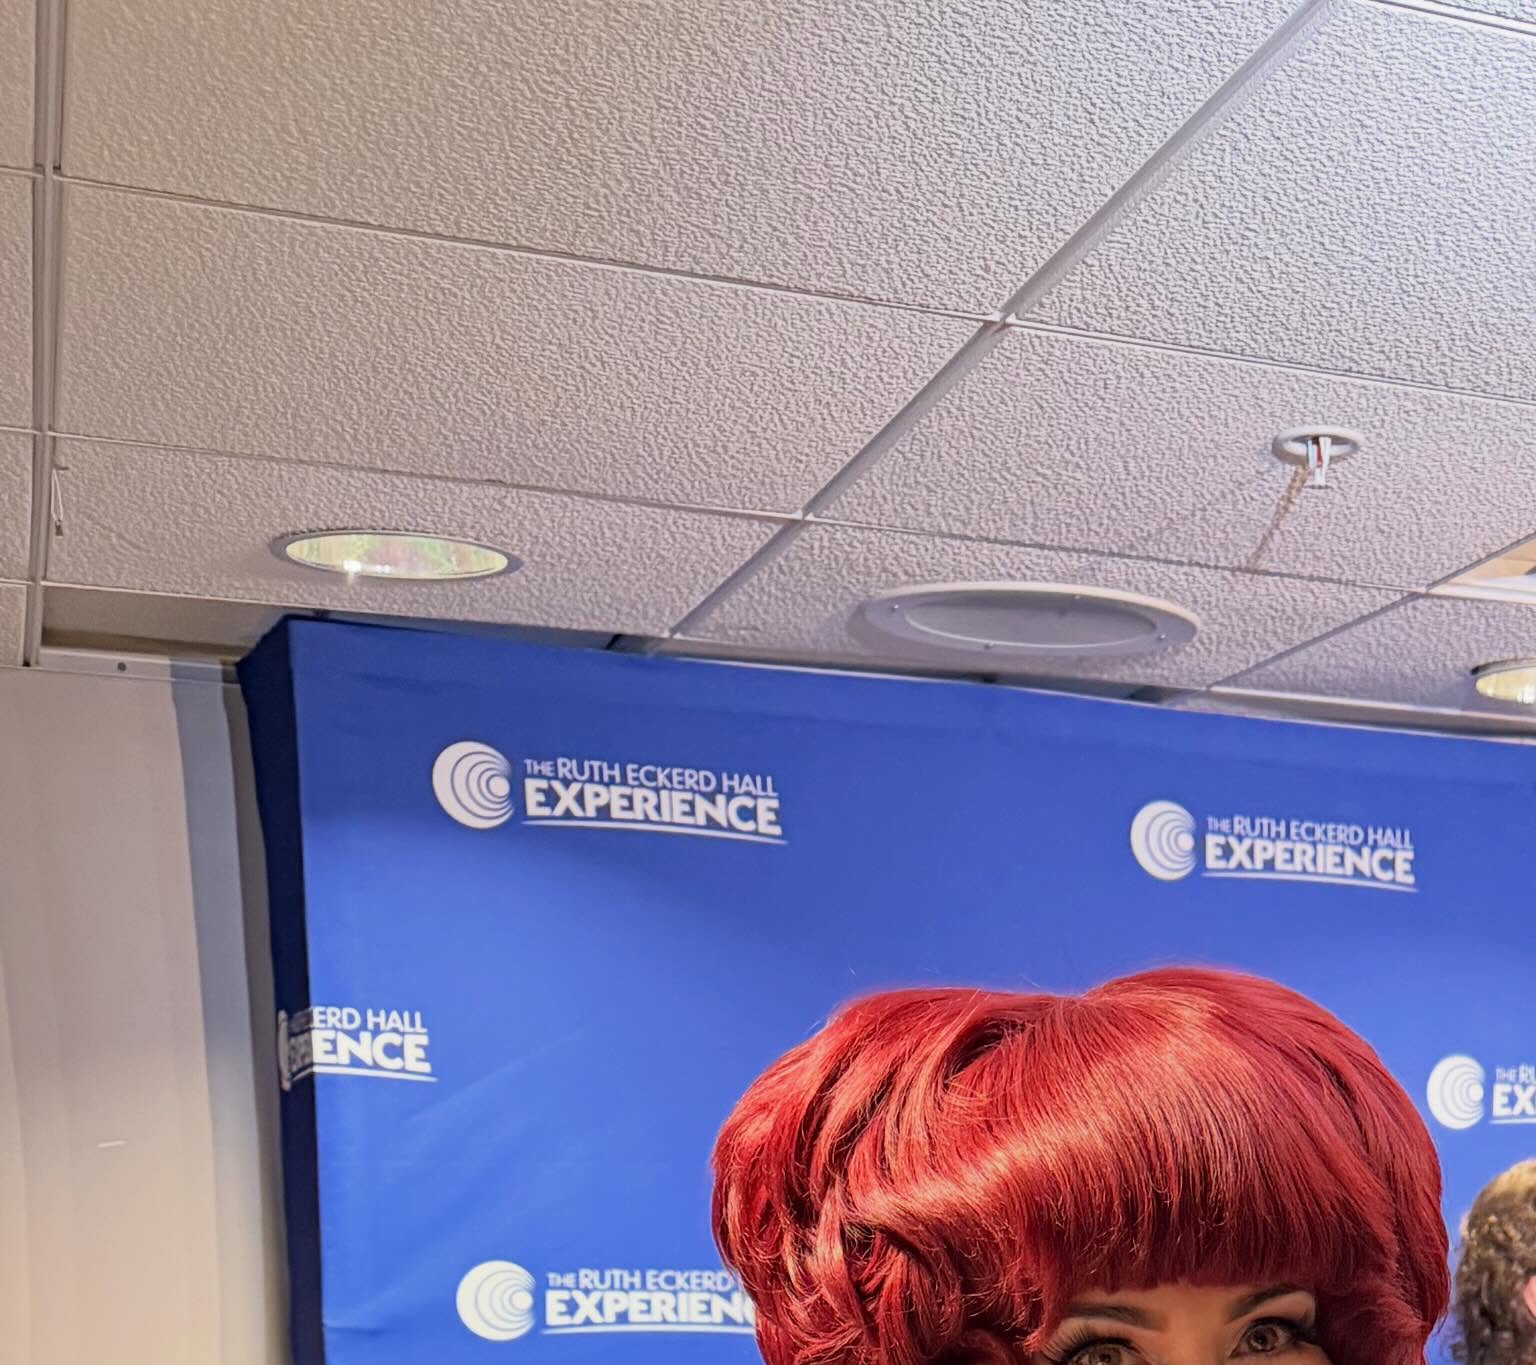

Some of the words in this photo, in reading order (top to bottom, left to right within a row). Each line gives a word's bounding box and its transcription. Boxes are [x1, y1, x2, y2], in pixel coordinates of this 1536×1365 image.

[524, 758, 555, 777] THE
[557, 757, 621, 784] RUTH
[626, 763, 716, 793] ECKERD
[721, 772, 779, 797] HALL
[524, 778, 782, 836] EXPERIENCE
[1206, 815, 1232, 834] THE
[1233, 814, 1285, 839] RUTH
[1289, 819, 1365, 845] ECKERD
[1367, 827, 1413, 849] HALL
[1205, 834, 1415, 885] EXPERIENCE
[313, 1006, 361, 1030] ERD
[366, 1008, 427, 1033] HALL
[546, 1271, 576, 1287] THE
[578, 1268, 641, 1290] RUTH
[646, 1269, 734, 1292] ECKERD
[545, 1290, 754, 1325] EXPERIEN
